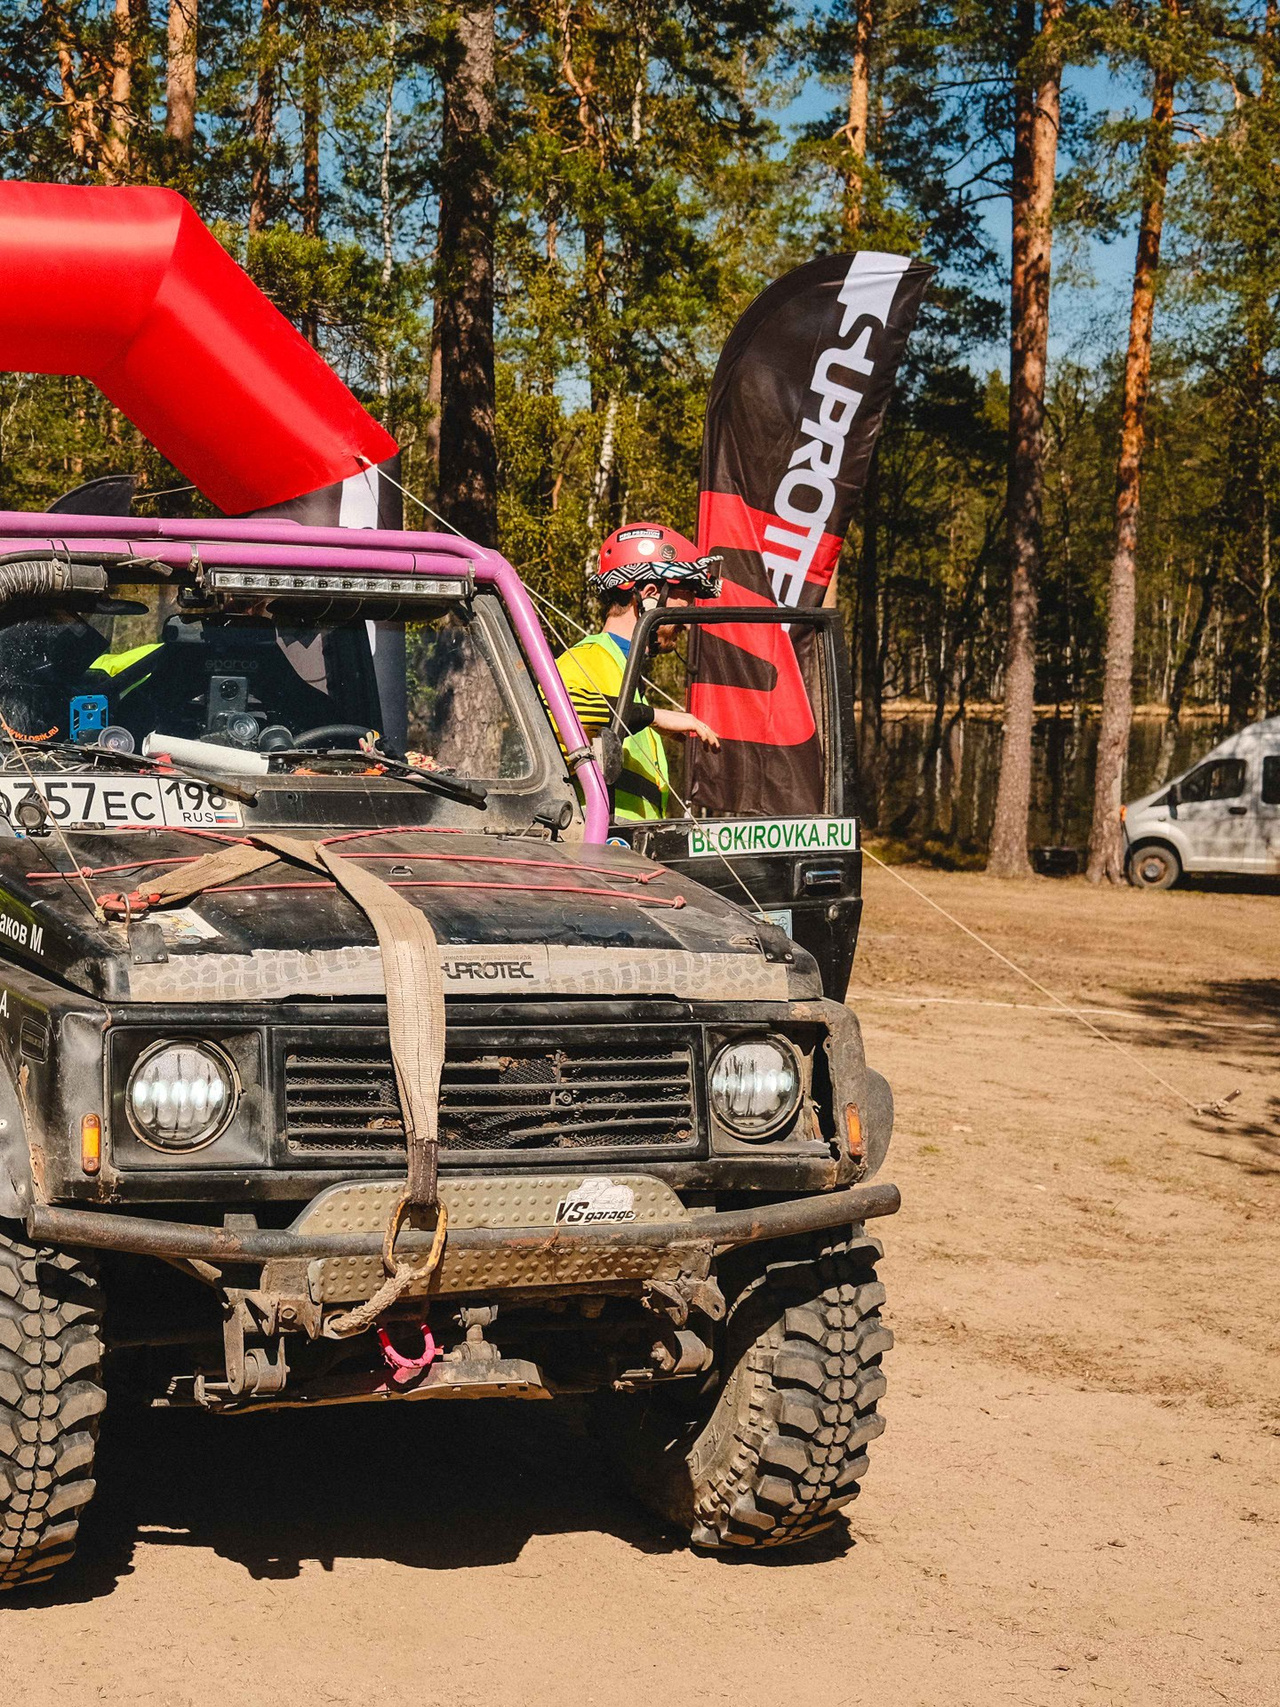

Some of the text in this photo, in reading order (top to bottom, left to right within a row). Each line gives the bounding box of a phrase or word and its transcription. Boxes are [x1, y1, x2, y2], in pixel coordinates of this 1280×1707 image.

[764, 298, 886, 632] SUPROTE
[183, 812, 213, 822] RUS
[692, 822, 852, 853] BLOKIROVKA.RU
[29, 923, 45, 956] М.
[556, 1202, 634, 1223] VS garage
